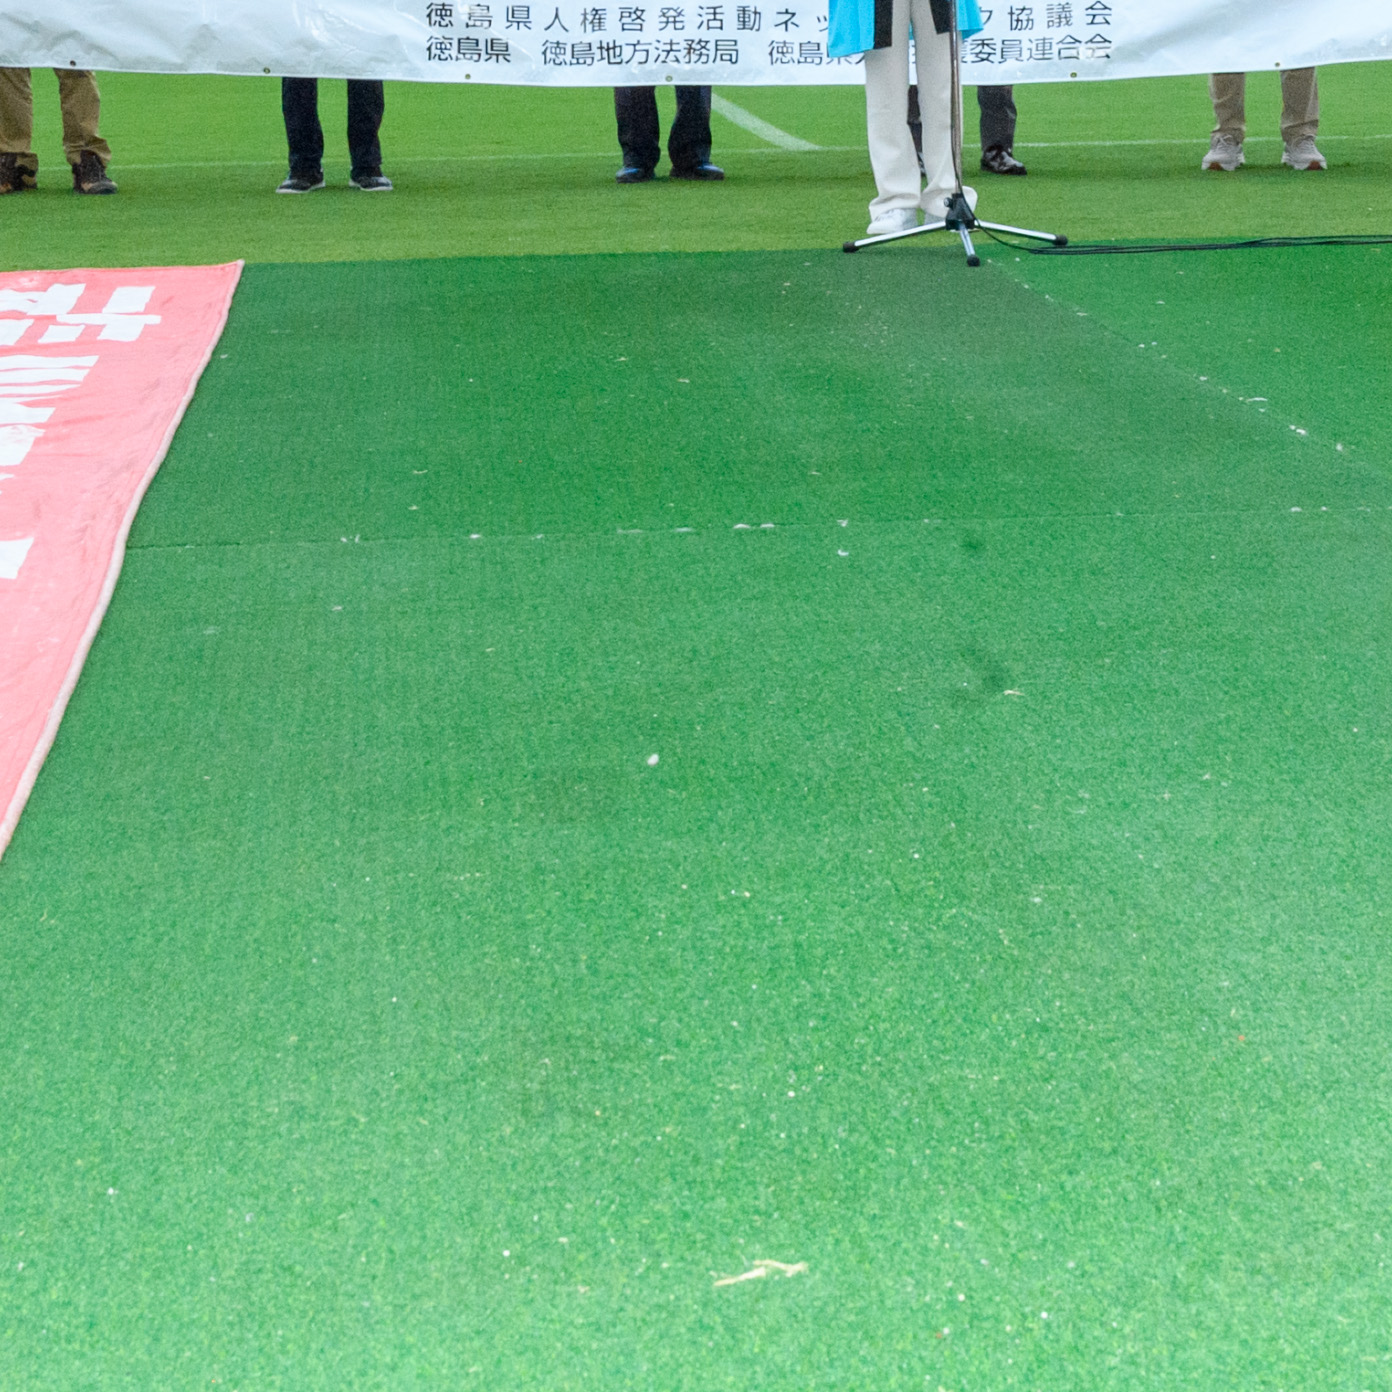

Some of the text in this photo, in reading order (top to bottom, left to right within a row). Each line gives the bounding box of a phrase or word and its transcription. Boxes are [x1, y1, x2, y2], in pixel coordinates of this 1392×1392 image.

[426, 35, 512, 64] 徳島県
[541, 38, 739, 67] 徳島地方法務局
